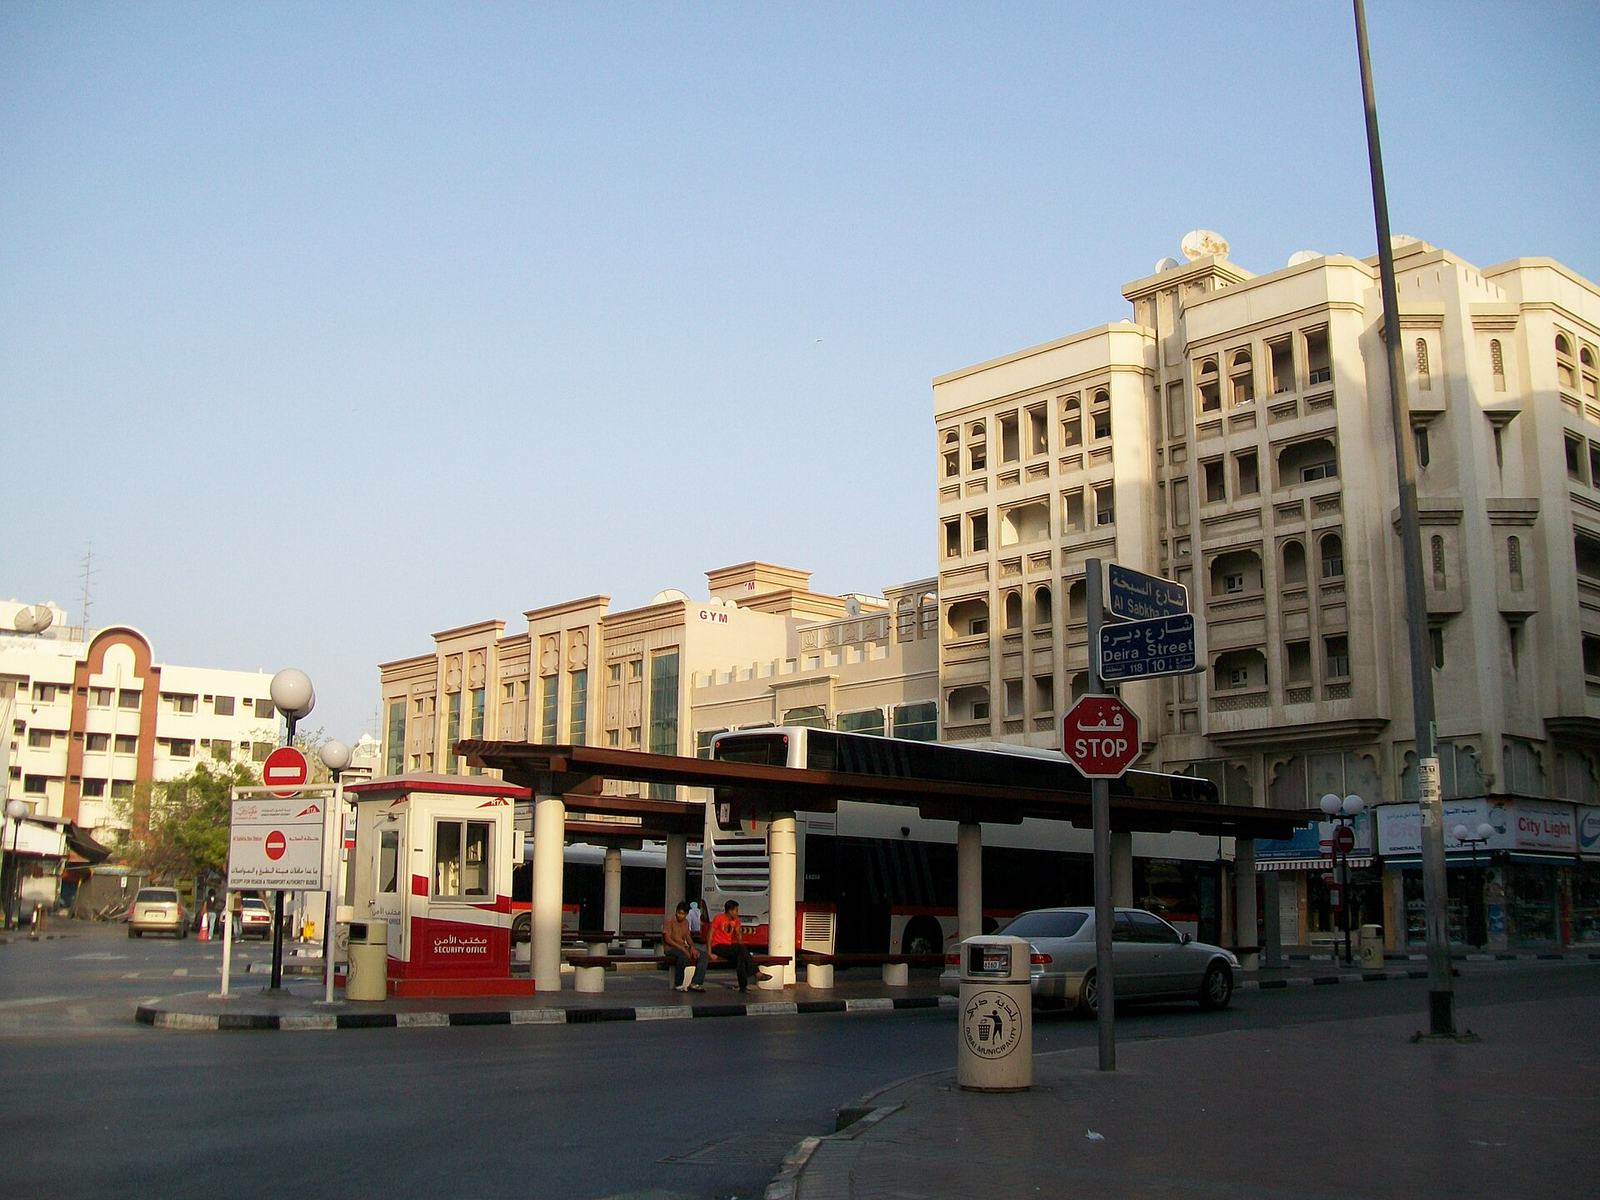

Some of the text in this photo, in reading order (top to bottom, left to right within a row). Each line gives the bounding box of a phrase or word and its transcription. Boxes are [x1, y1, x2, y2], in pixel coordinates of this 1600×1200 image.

[1113, 571, 1184, 607] شارع السبخة
[700, 610, 727, 624] GYM
[1114, 594, 1123, 610] Al
[1128, 598, 1160, 618] Sabkha
[1145, 618, 1192, 644] شارع
[1103, 639, 1193, 663] Deira Street
[1130, 663, 1143, 674] 118
[1152, 659, 1165, 672] 10
[1077, 705, 1124, 732] قف
[1075, 738, 1128, 758] STOP
[1518, 816, 1541, 836] City
[1543, 819, 1571, 838] Light
[433, 946, 488, 954] SECURITY OFFICE
[434, 934, 487, 946] مكتب الأمن
[976, 1027, 1017, 1056] MUNICIPALITY
